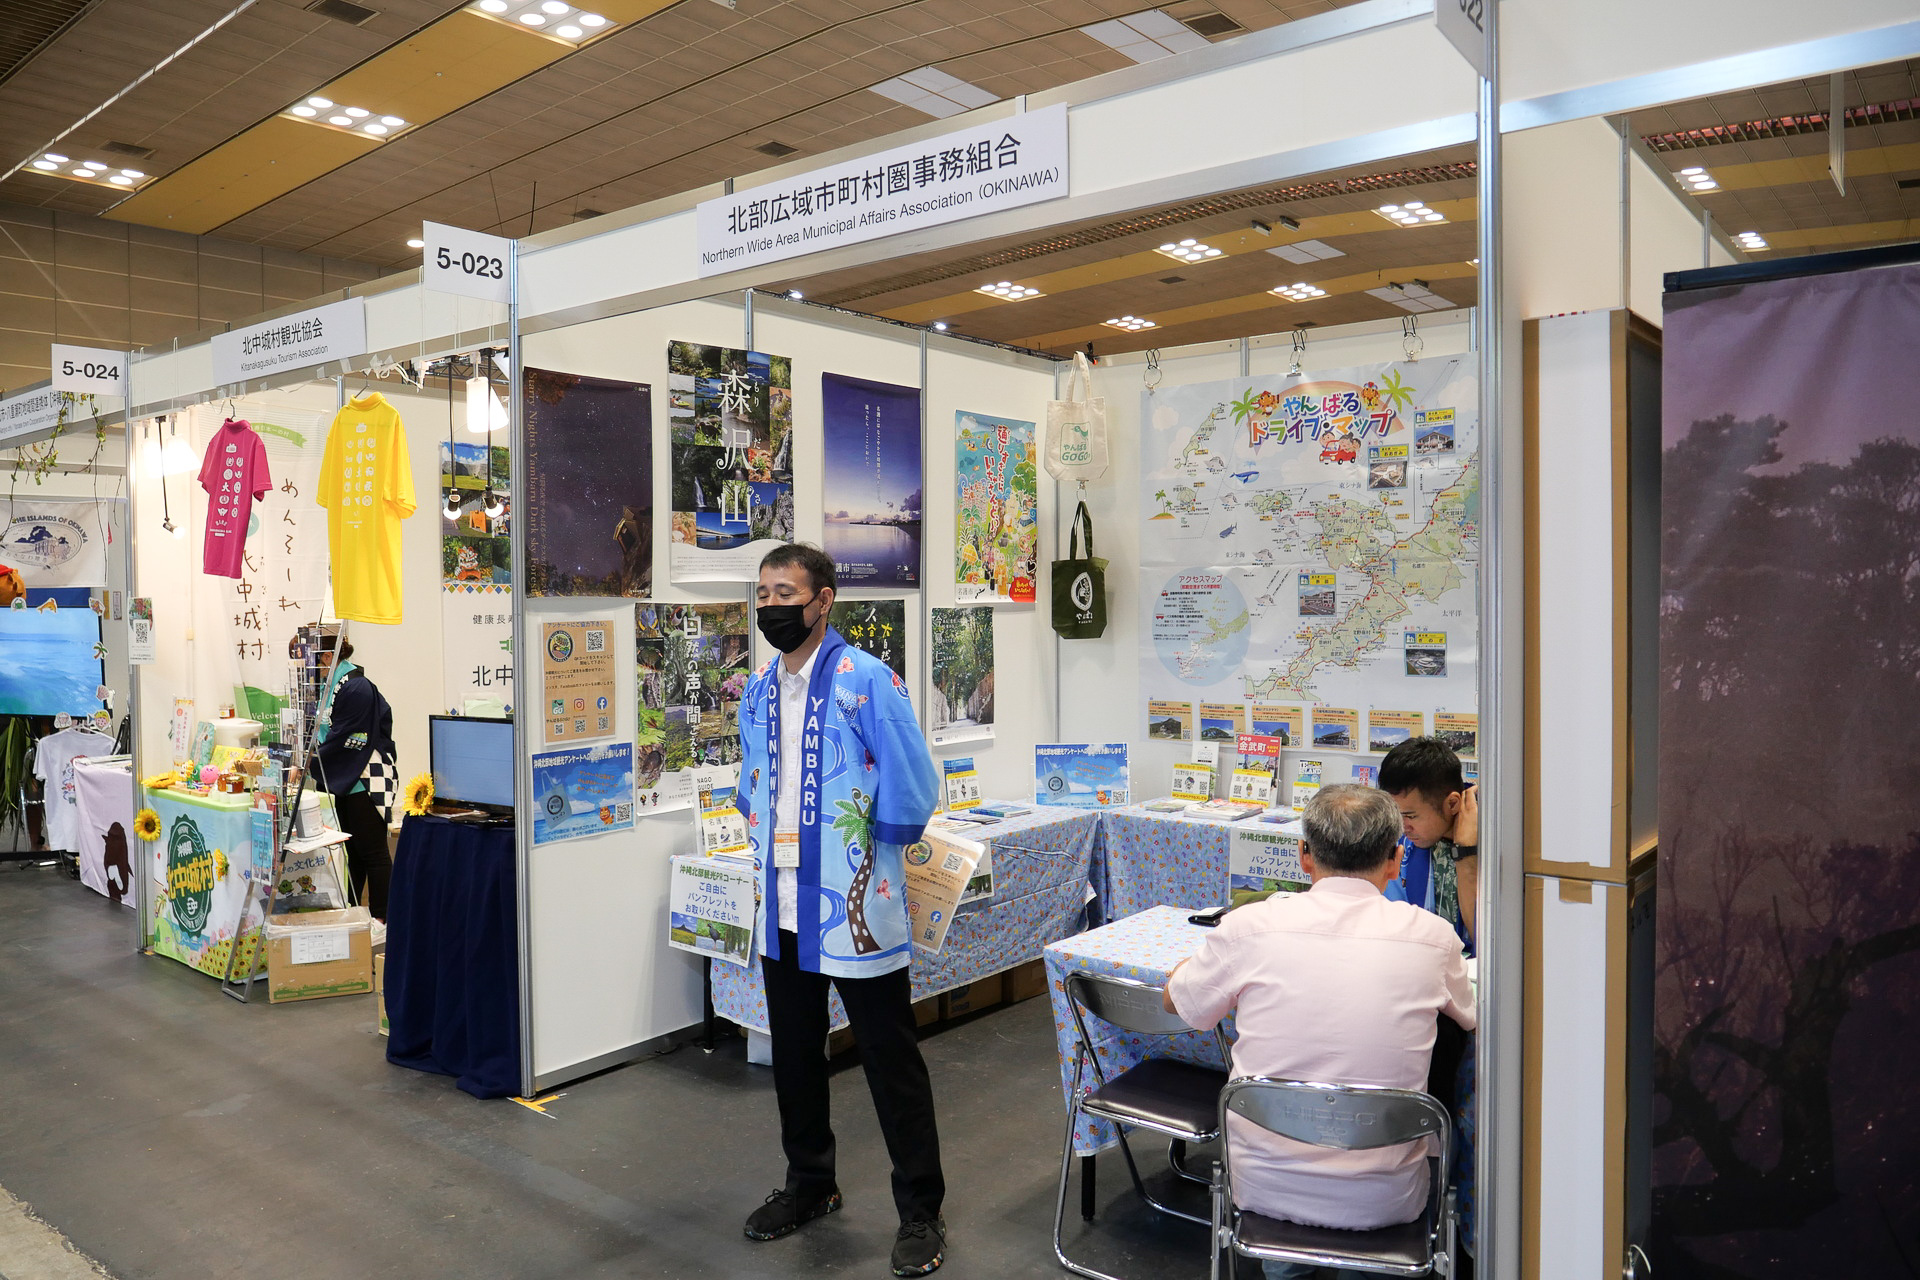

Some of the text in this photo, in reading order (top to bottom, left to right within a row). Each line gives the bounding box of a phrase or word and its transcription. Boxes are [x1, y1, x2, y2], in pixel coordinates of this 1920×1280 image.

[728, 132, 1021, 236] 北部広域市町村圏事務組合
[702, 166, 1059, 265] Northern Wide Area Municipal Affairs Association (OKINAWA)
[436, 246, 503, 280] 5-023
[242, 317, 323, 356] 北中城村観光協会
[61, 360, 119, 381] 5-024
[240, 345, 328, 372] Kitanakagusuku Tourism Association
[527, 372, 538, 407] Starry
[1283, 391, 1362, 421] やんばる
[527, 411, 538, 448] Nights
[716, 369, 755, 527] 森沢山
[529, 451, 539, 502] Yambaru
[13, 515, 27, 524] HE
[529, 506, 539, 534] Dark
[280, 478, 301, 612] めんそーれ
[529, 537, 539, 554] sky
[683, 615, 703, 759] 自然の声が聞こえる
[767, 684, 778, 810] OKINAWA
[801, 696, 825, 826] YAMBARU
[1239, 741, 1267, 753] 金武町
[696, 776, 713, 784] NAGO
[697, 783, 714, 791] GUIDE
[1251, 855, 1300, 869] パンフレット
[1264, 846, 1297, 858] ご自由に
[687, 892, 737, 911] パンフレットを
[699, 881, 727, 896] ご自由に
